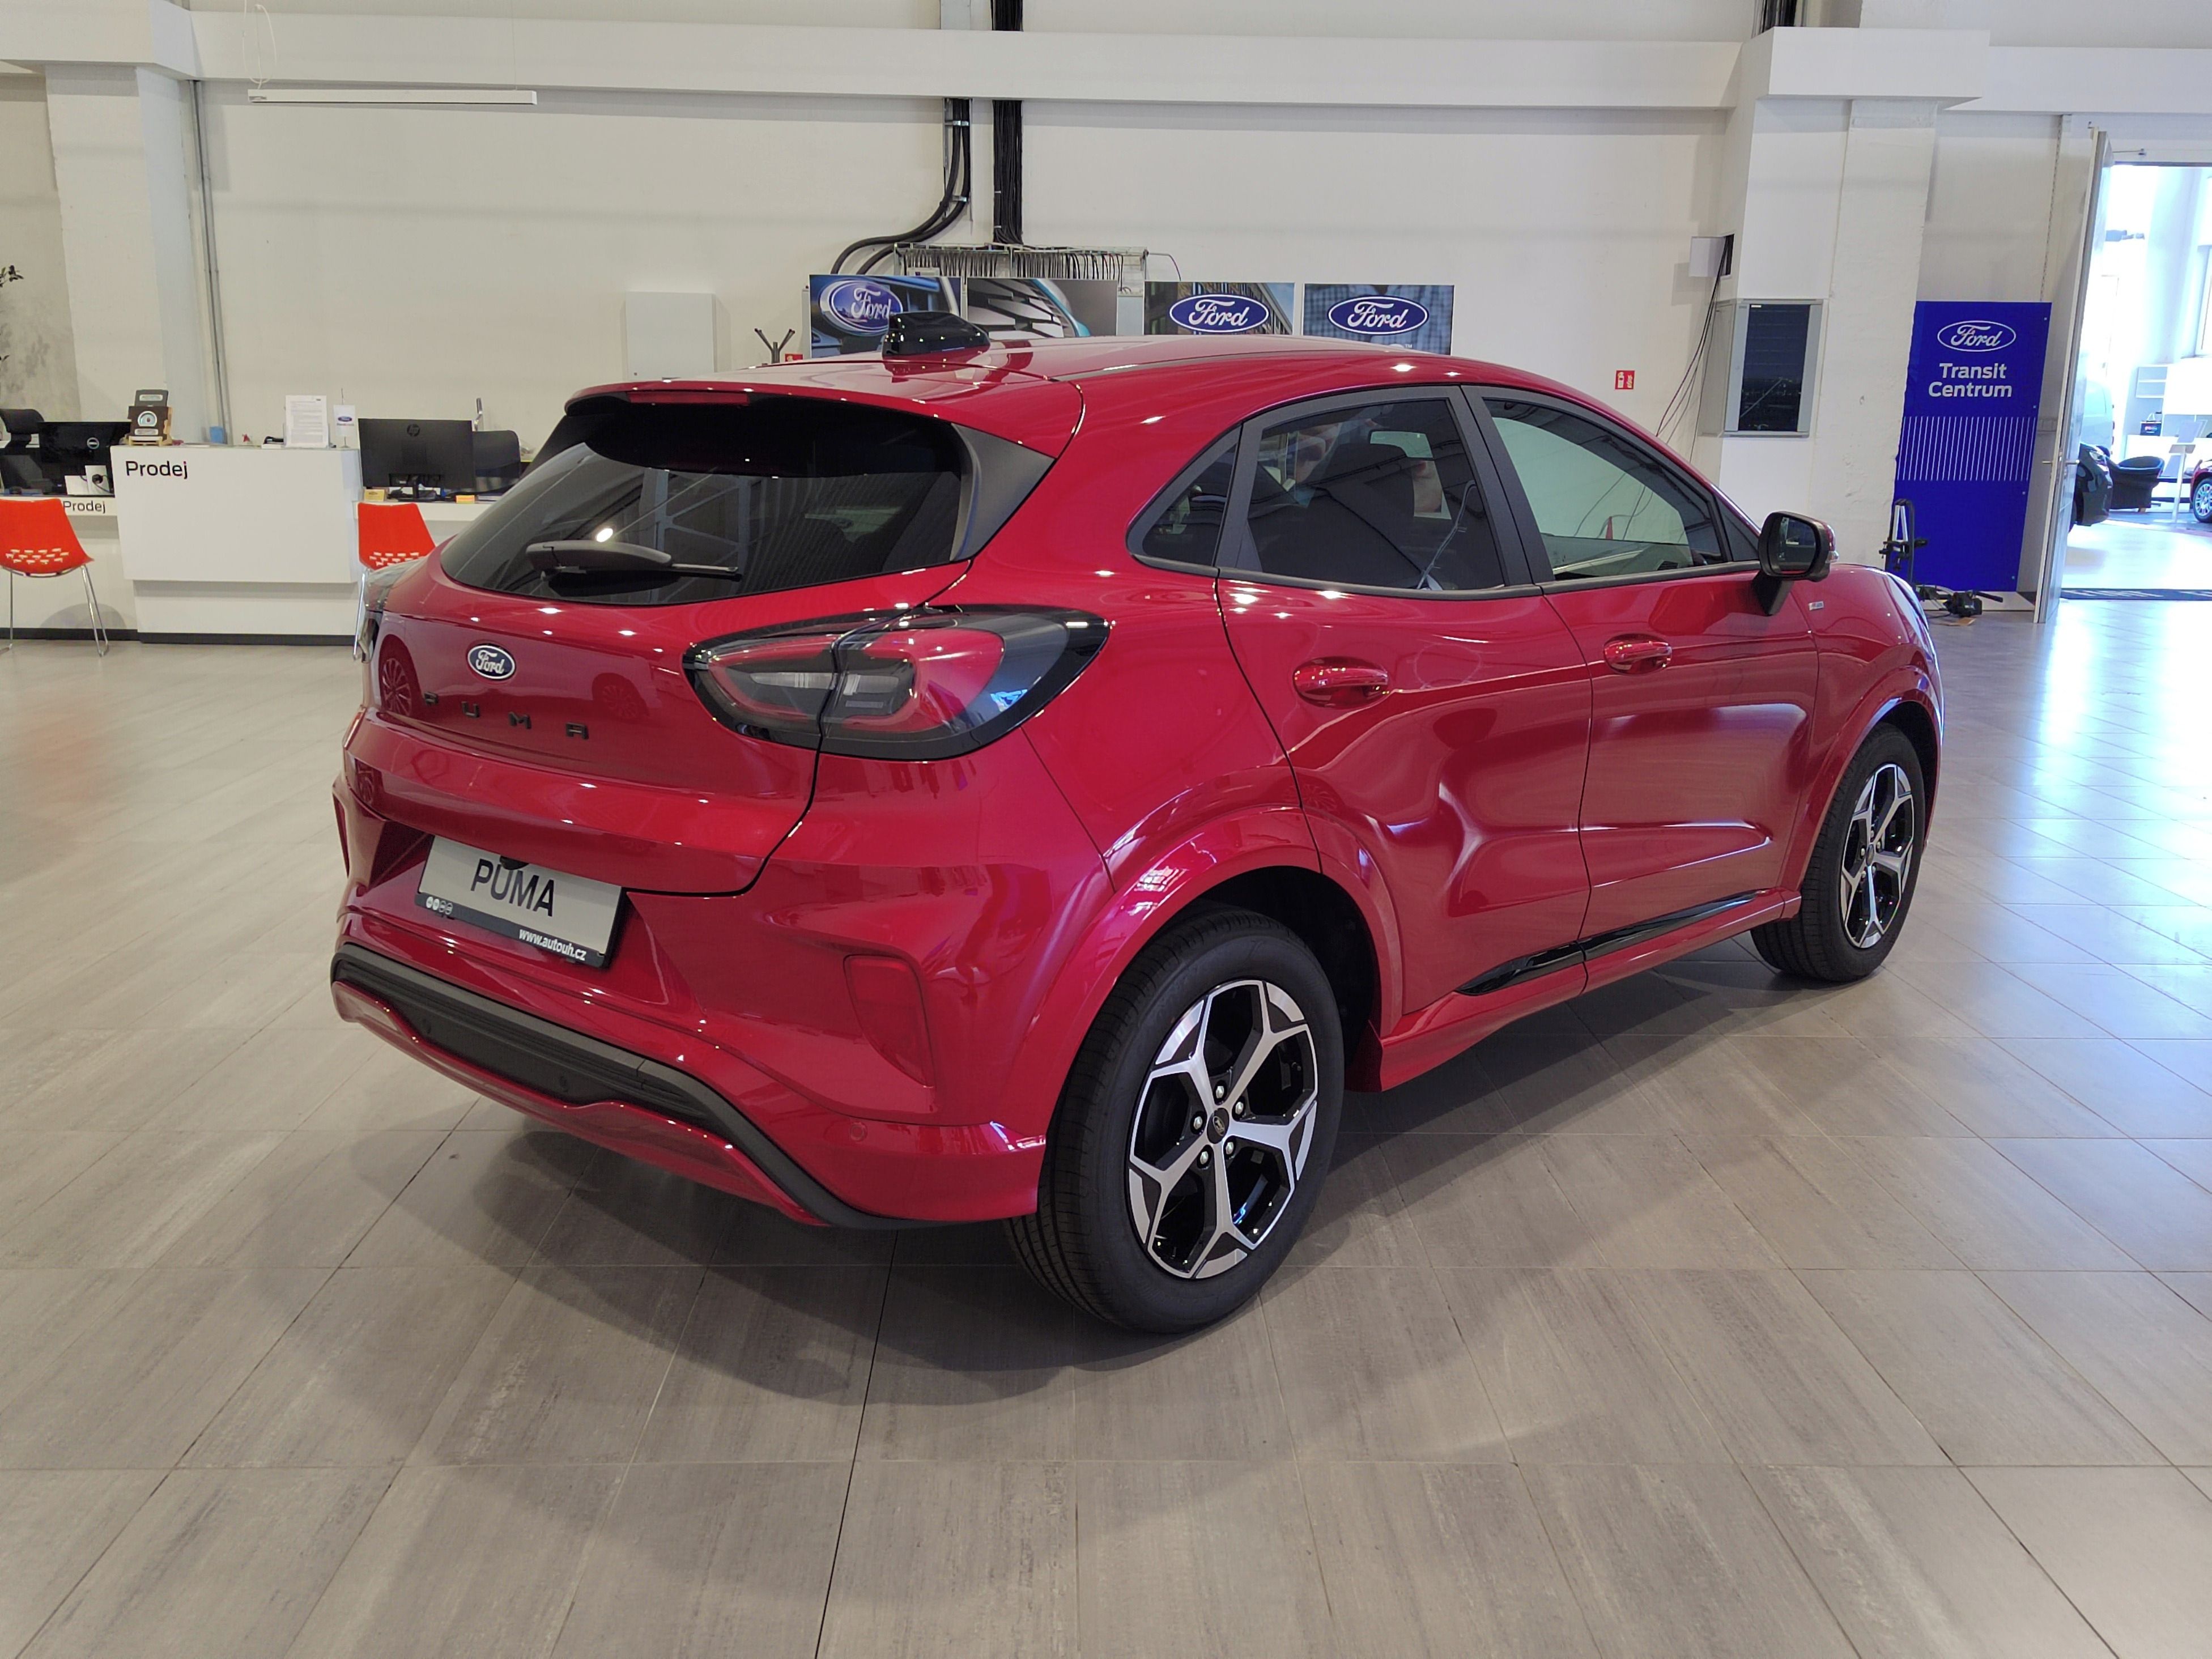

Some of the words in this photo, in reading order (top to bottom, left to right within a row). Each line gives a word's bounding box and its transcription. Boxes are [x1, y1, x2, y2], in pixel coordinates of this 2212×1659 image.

[1939, 363, 2007, 379] Transit
[1928, 381, 2012, 398] Centrum
[125, 461, 188, 480] Prodej
[63, 500, 106, 514] Prodej
[470, 858, 555, 917] PUMA
[518, 929, 587, 961] www.autouh.cz
